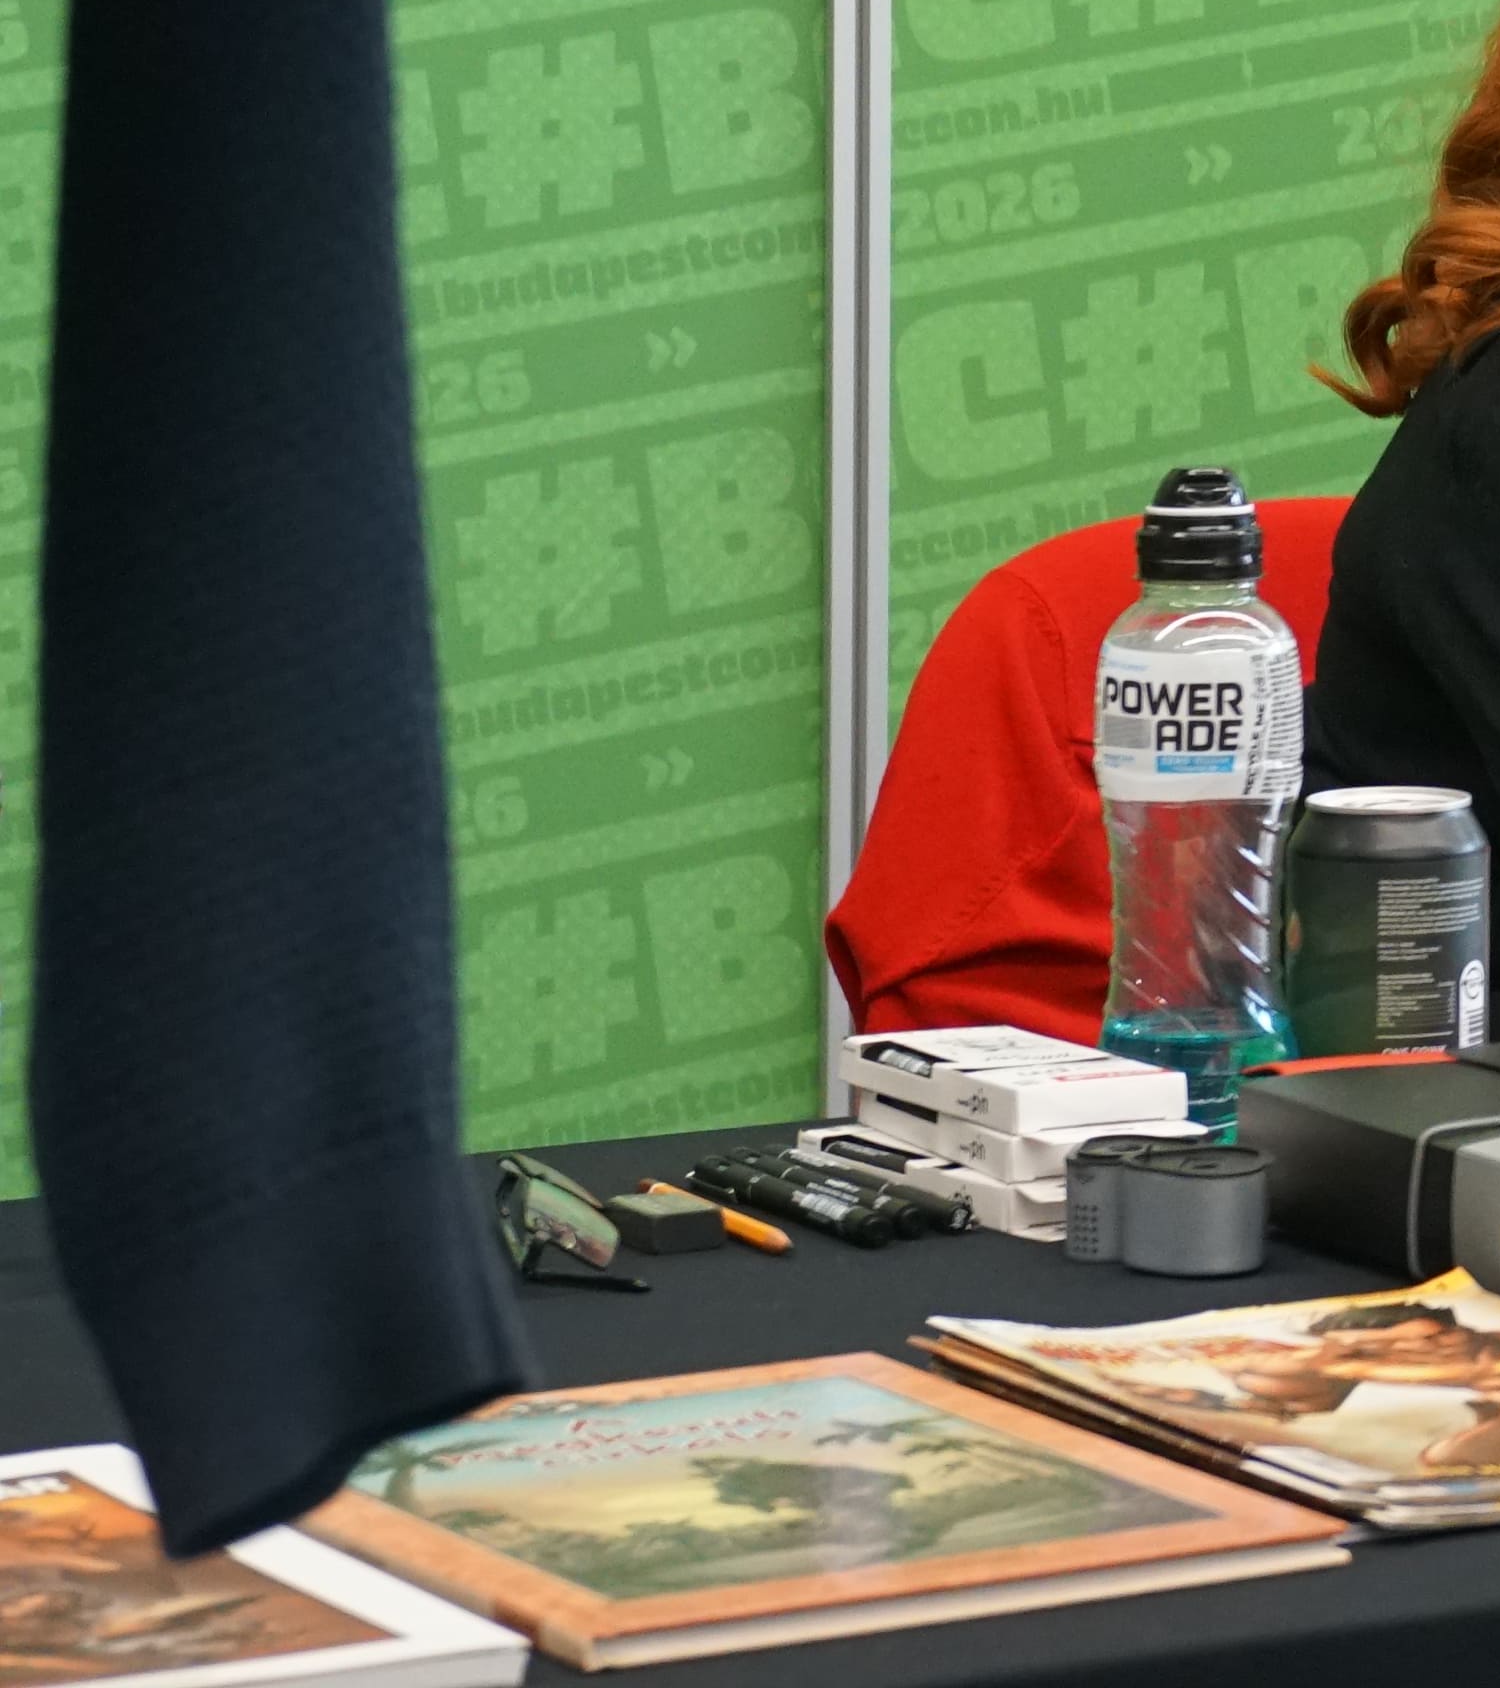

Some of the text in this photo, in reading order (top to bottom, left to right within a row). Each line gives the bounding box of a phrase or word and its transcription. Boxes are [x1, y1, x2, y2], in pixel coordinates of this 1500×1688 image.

[893, 161, 1081, 246] 2026
[1102, 676, 1244, 717] POWER
[1156, 718, 1243, 753] ADE
